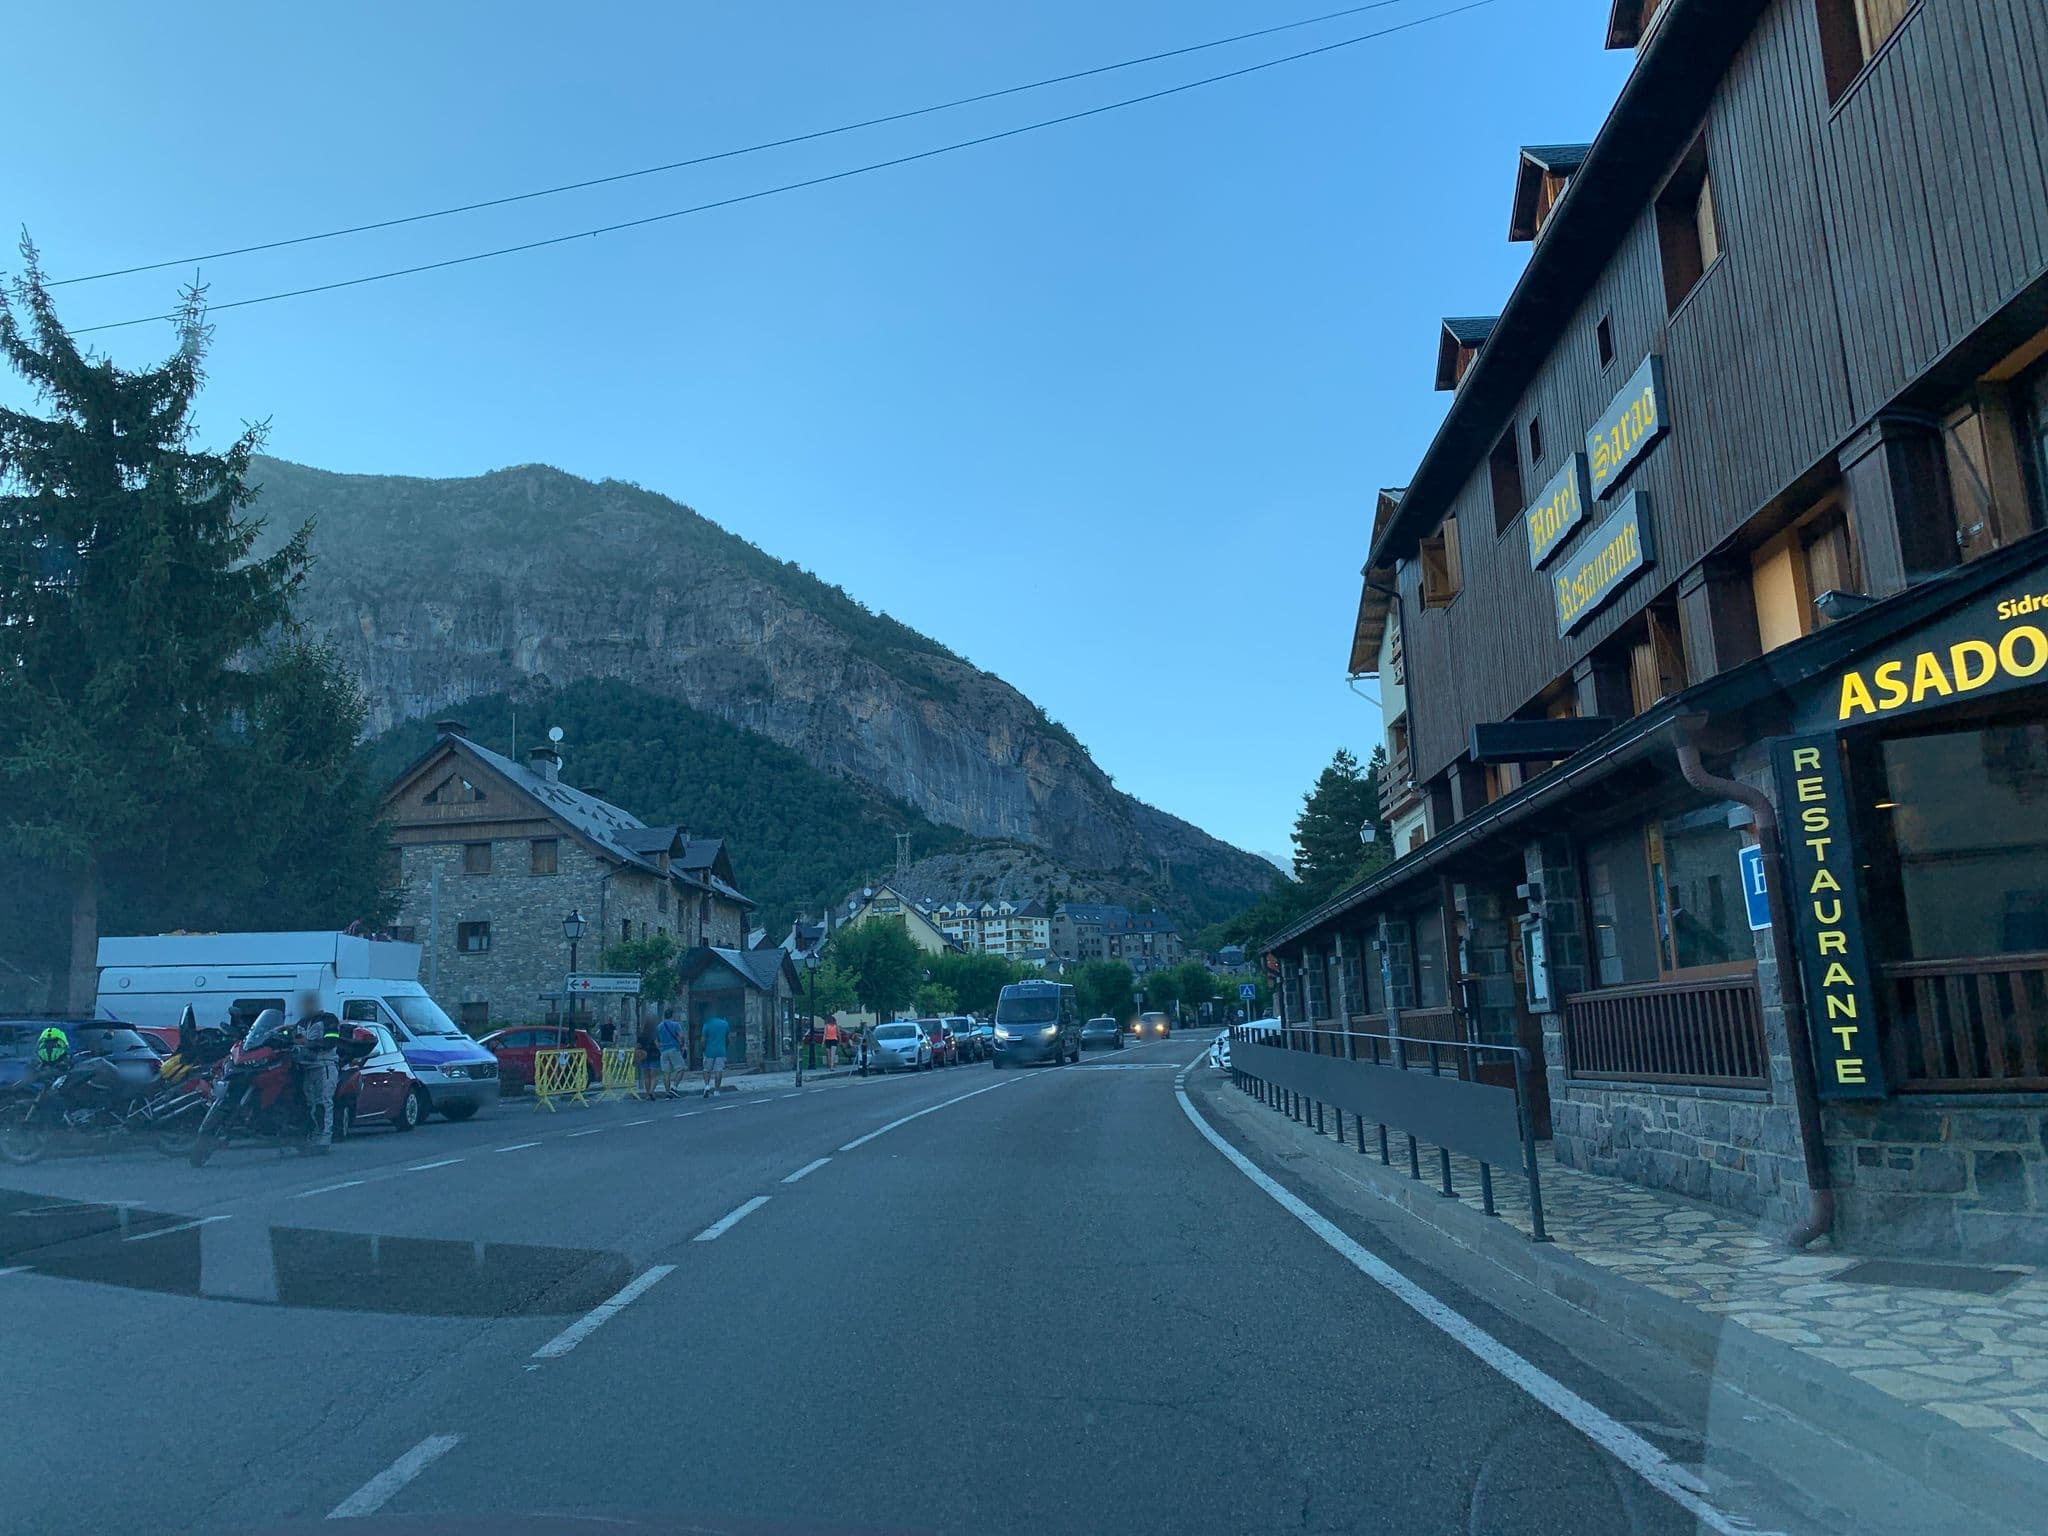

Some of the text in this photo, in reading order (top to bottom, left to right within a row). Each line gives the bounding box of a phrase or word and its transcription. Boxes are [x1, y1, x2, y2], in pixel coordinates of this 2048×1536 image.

[1529, 465, 1577, 556] Hotel
[1558, 521, 1637, 621] Restaurante
[1838, 625, 2048, 720] ASADO
[1792, 746, 1866, 1084] RESTAURANTE
